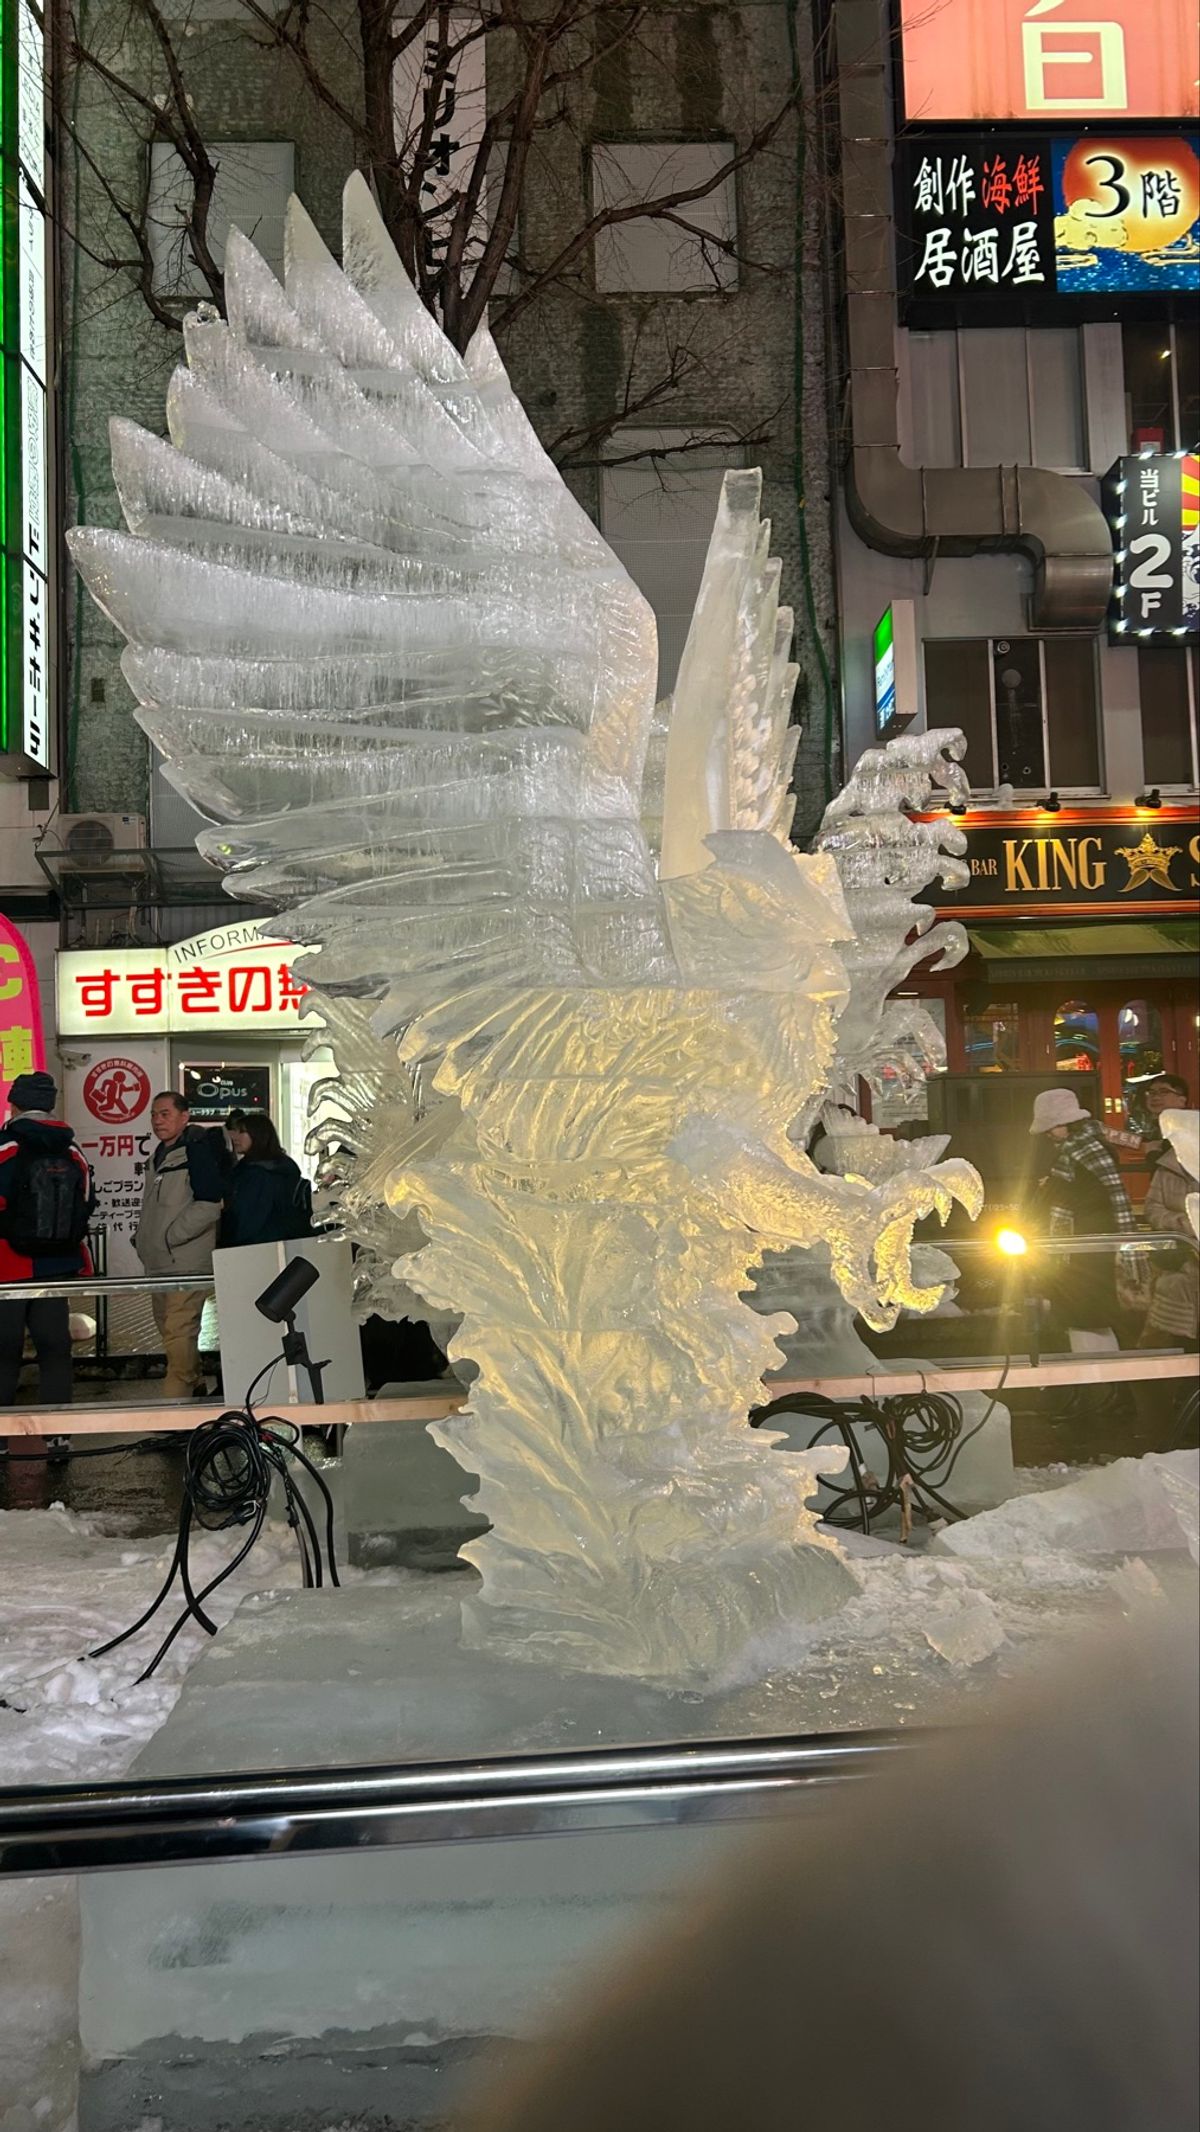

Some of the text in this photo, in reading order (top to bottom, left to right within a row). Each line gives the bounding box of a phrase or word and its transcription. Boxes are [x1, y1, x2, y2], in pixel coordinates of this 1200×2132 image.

[913, 154, 1044, 217] 創作海鮮
[1084, 155, 1182, 219] 3階
[913, 221, 1045, 288] 居酒屋
[1140, 468, 1159, 526] 当ビル
[971, 858, 998, 876] BAR
[1003, 837, 1107, 891] KING
[174, 926, 267, 963] INFORM
[197, 1082, 248, 1100] Opus
[81, 1133, 151, 1157] 一万円で
